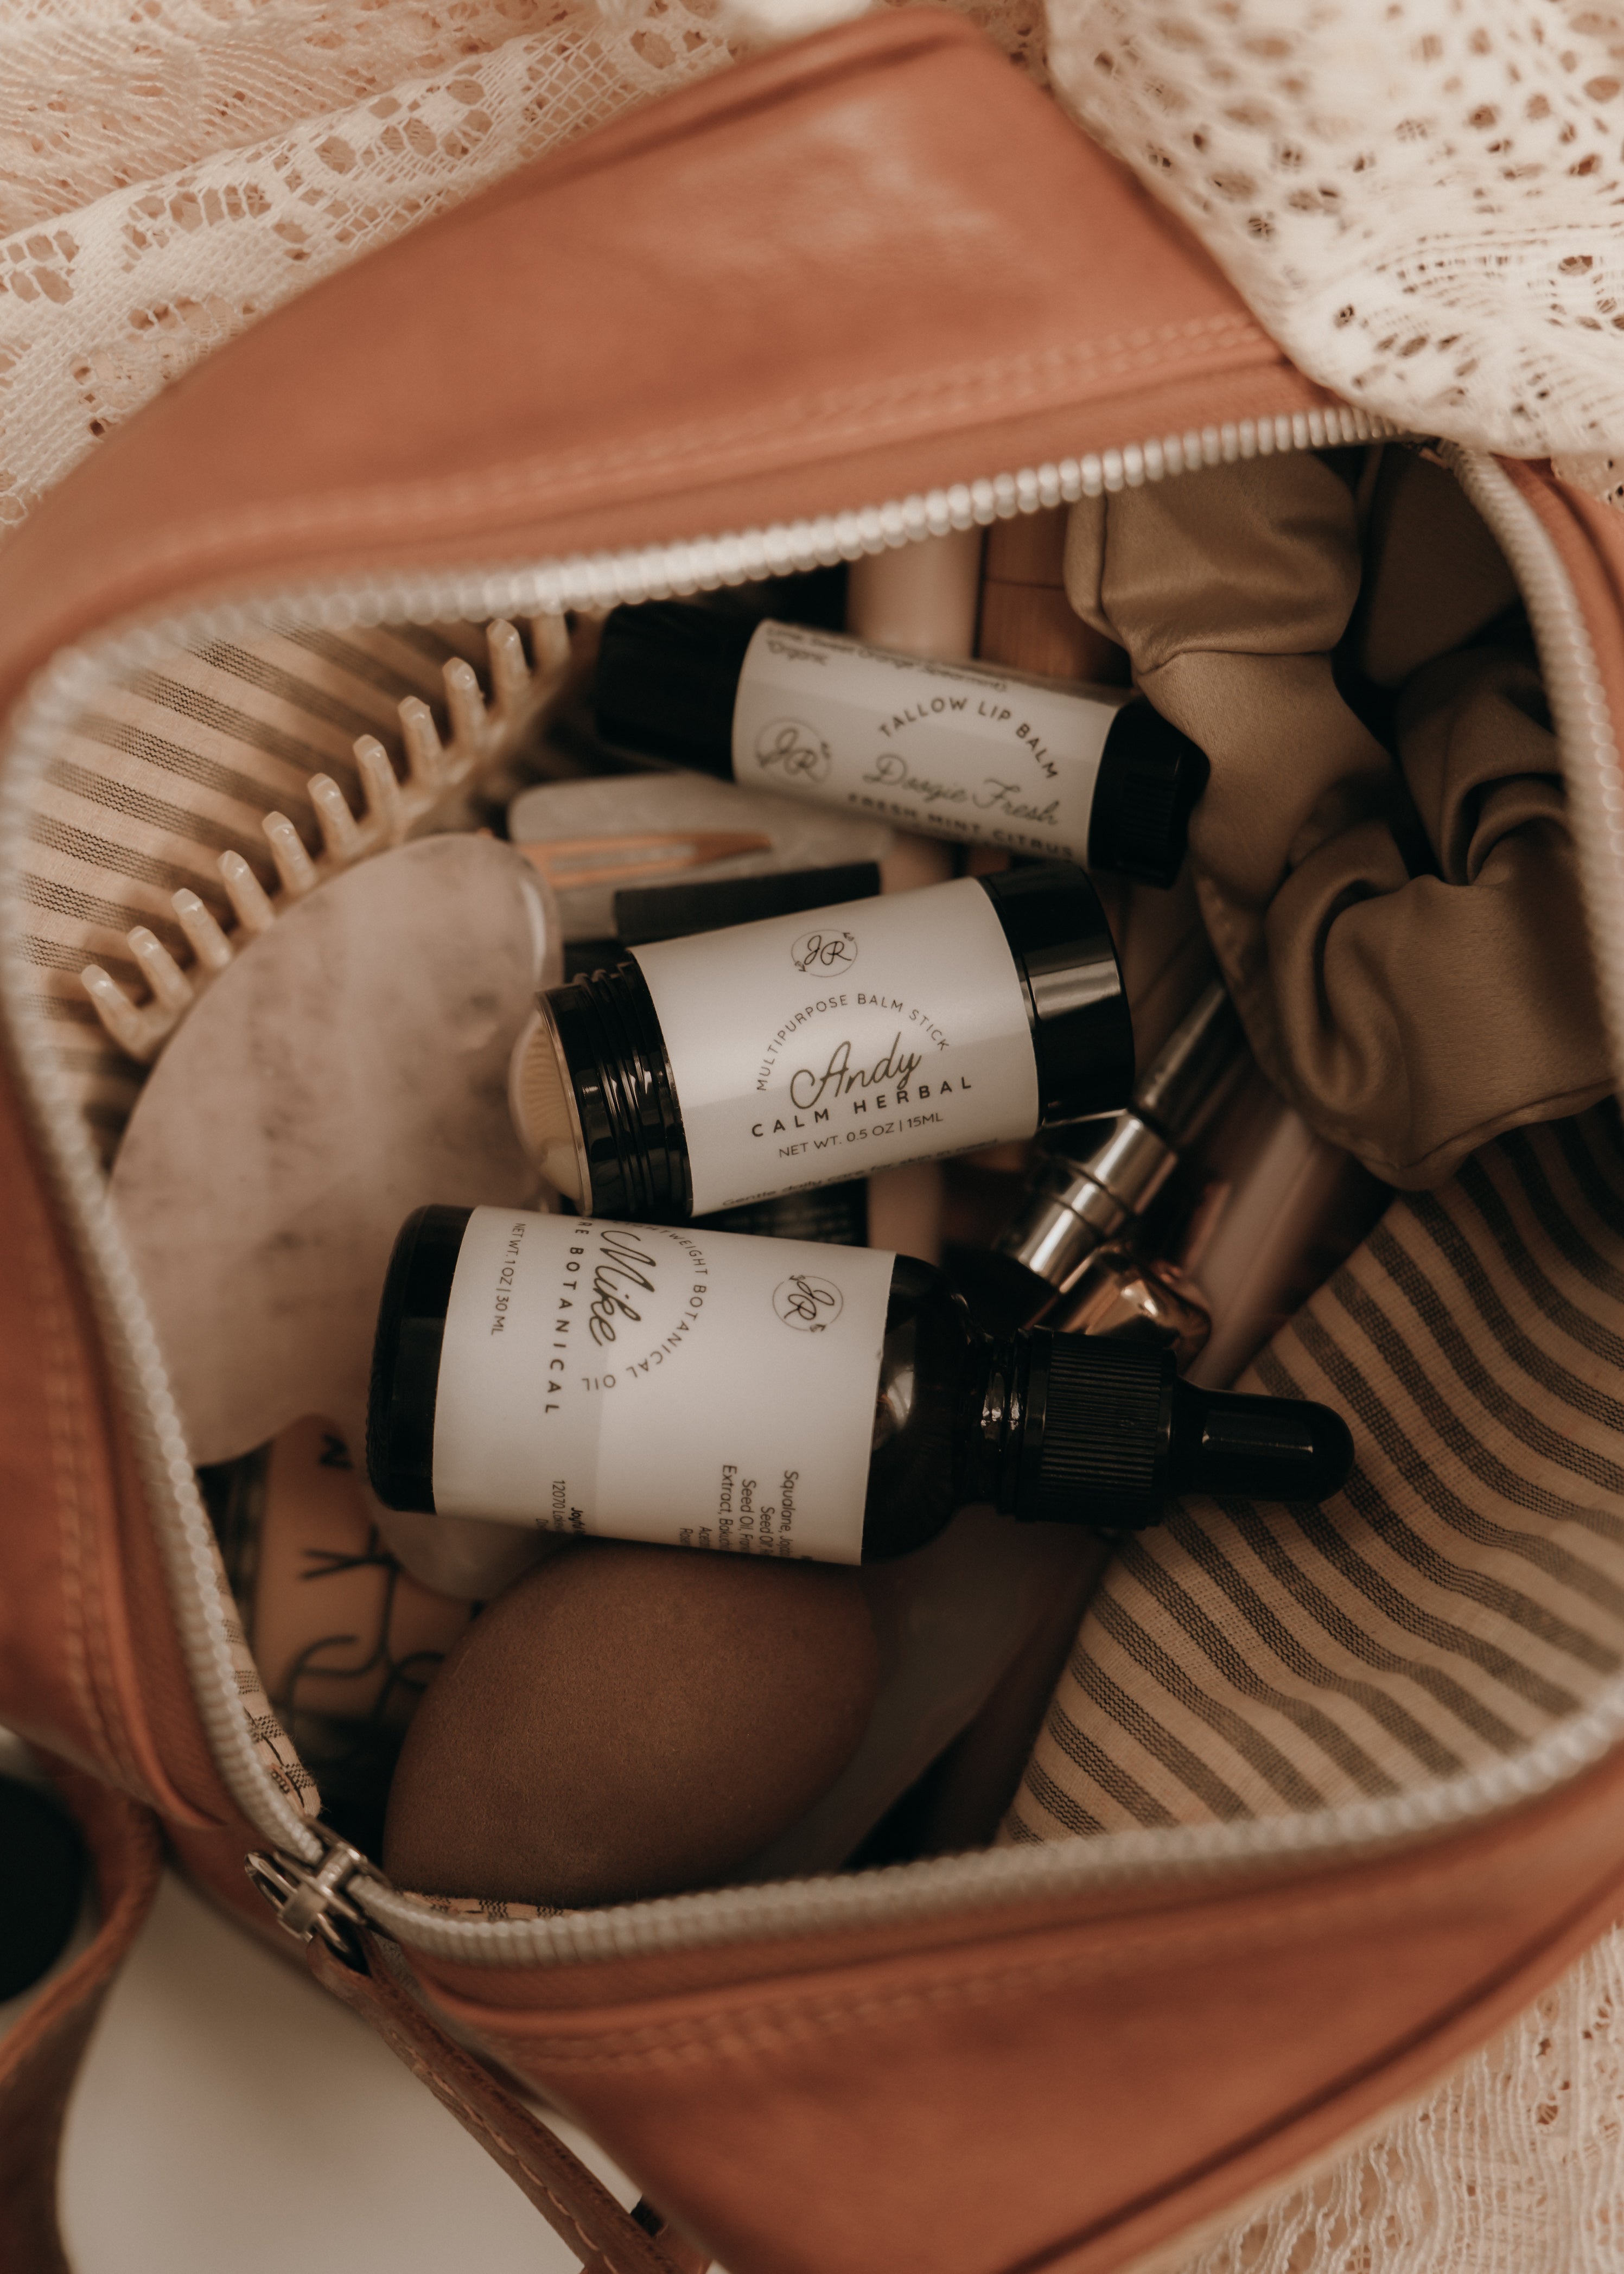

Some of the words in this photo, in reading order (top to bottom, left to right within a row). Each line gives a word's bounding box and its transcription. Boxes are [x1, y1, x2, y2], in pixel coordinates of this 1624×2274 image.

[878, 697, 968, 737] TALLOW
[977, 700, 1011, 721] LIP
[1016, 723, 1058, 779] BALM
[972, 777, 1060, 826] Fresh
[928, 813, 981, 833] MINT
[992, 829, 1074, 858] CITRUS
[757, 994, 848, 1091] MULTIPURPOSE
[857, 993, 903, 1012] BALM
[909, 1009, 950, 1051] STICK
[790, 1031, 922, 1110] Andy
[752, 1108, 830, 1137] CALM
[853, 1077, 972, 1114] HERBAL
[779, 1142, 808, 1158] NET
[814, 1135, 842, 1150] WT.
[846, 1129, 868, 1142] 0.5
[872, 1122, 895, 1136] OZ
[907, 1112, 944, 1129] 15ML
[723, 1189, 777, 1207] Gentle
[781, 1180, 823, 1193] daily
[827, 1169, 866, 1183] care
[871, 1162, 893, 1173] for
[506, 1239, 521, 1257] WT.
[512, 1222, 527, 1238] NET
[499, 1267, 514, 1285] OZ
[589, 1230, 657, 1347] Mike
[491, 1315, 506, 1336] ML
[495, 1295, 510, 1311] 30
[545, 1246, 584, 1415] BOTANICAL
[626, 1284, 708, 1378] BOTANICAL
[582, 1374, 616, 1392] OIL
[552, 1480, 566, 1509] 12070
[717, 1464, 737, 1514] Extract,
[740, 1479, 757, 1513] Seed
[778, 1469, 799, 1533] Squalane,
[568, 1507, 585, 1530] Joyful
[737, 1515, 754, 1531] Oil,
[760, 1506, 775, 1534] Seed
